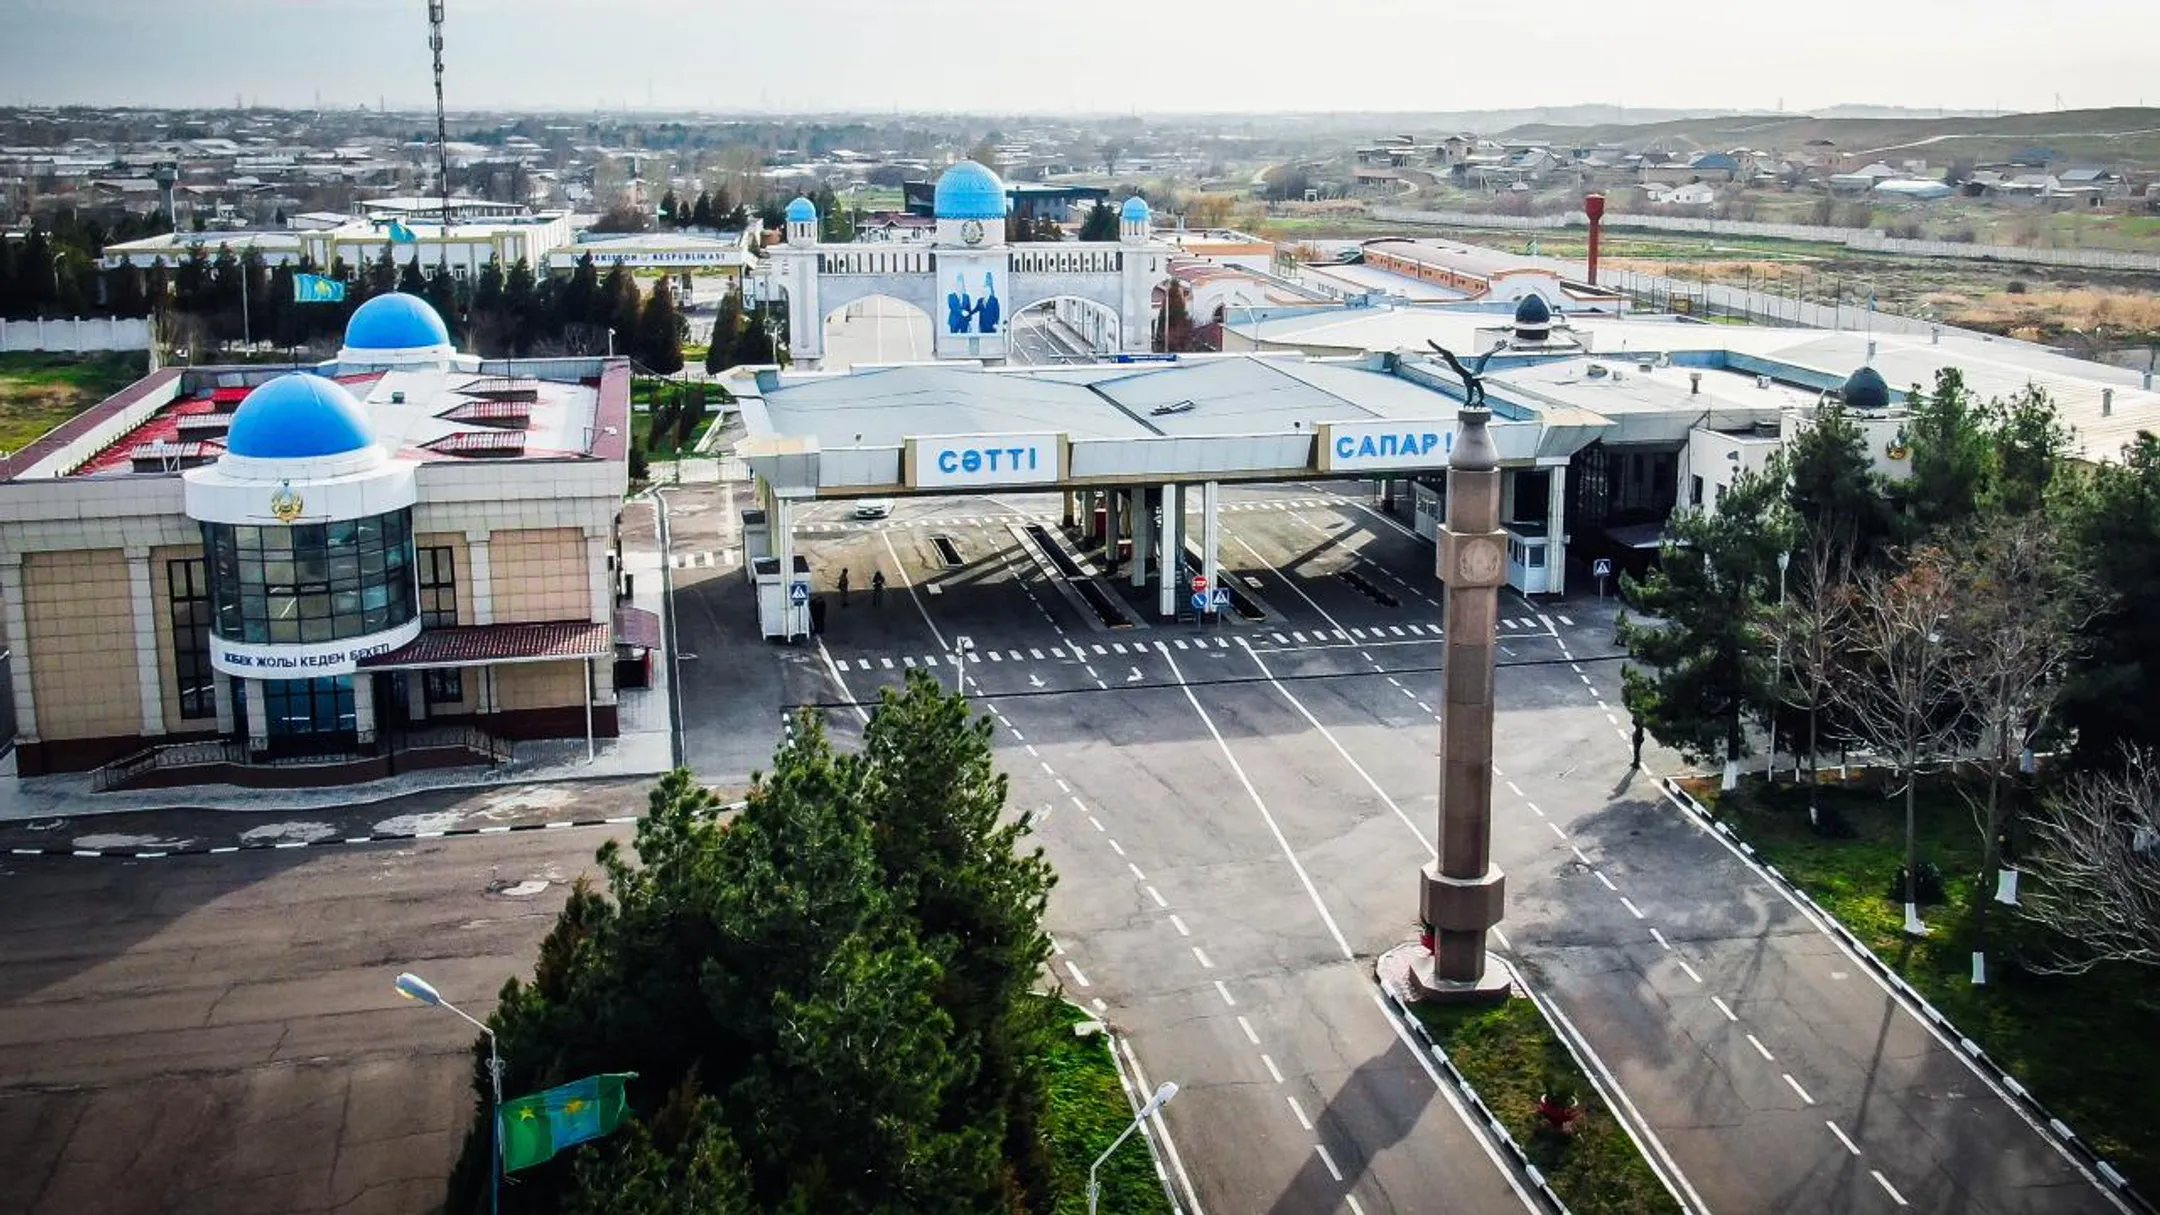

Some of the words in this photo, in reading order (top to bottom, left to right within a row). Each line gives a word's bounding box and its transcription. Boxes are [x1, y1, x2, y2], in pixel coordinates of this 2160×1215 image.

[938, 447, 1036, 473] СӘТТІ
[256, 655, 297, 668] ЖОЛЫ
[300, 652, 346, 667] КЕДЕН
